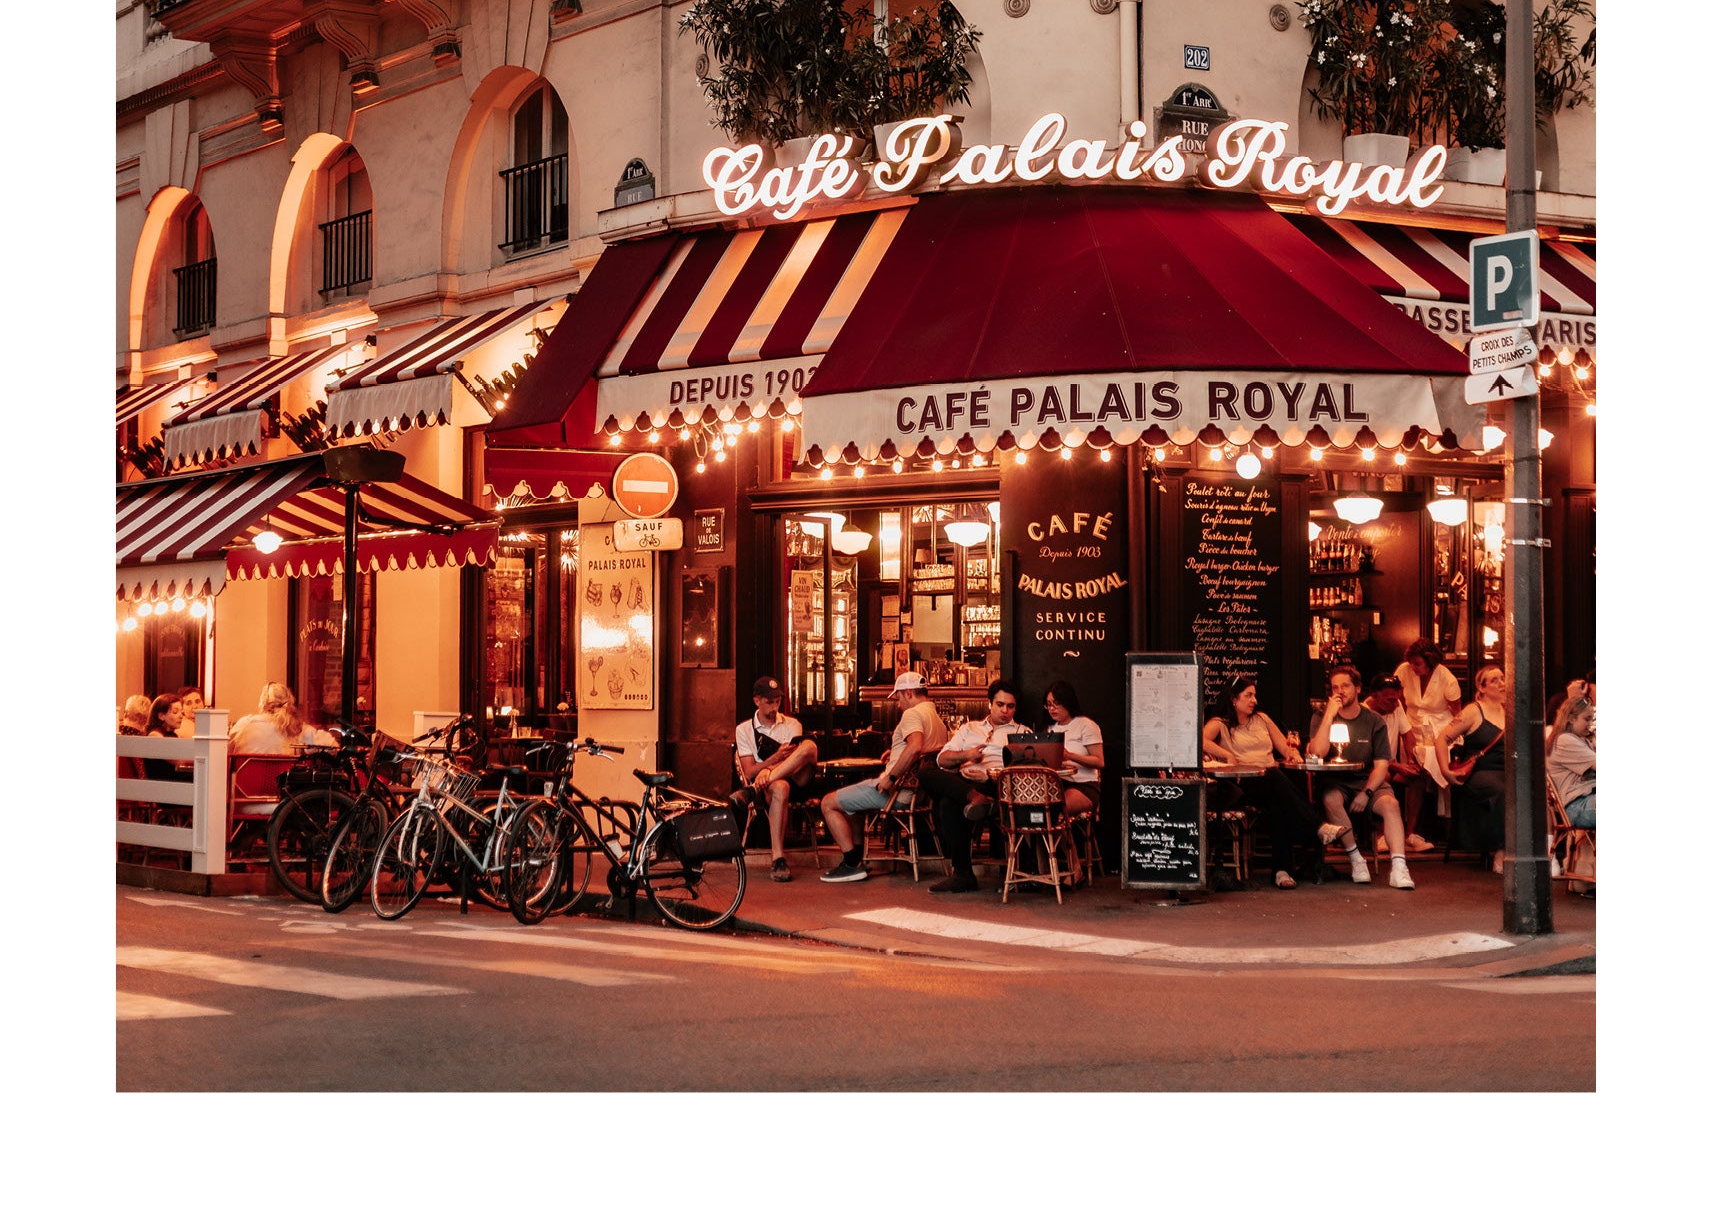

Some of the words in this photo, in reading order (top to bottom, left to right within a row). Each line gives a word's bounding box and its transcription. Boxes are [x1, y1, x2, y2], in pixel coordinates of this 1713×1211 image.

[1187, 48, 1208, 67] 202
[1182, 120, 1209, 136] RUE
[703, 134, 859, 220] Café
[874, 113, 1187, 193] Palais
[1208, 119, 1445, 216] Royal
[1487, 255, 1513, 311] P
[1480, 339, 1499, 353] CROIX
[1501, 336, 1514, 348] DES
[1472, 354, 1496, 370] PETITS
[1498, 345, 1533, 365] CHAMPS
[669, 373, 755, 406] DEPUIS
[896, 385, 992, 434] CAFÉ
[1010, 381, 1182, 428] PALAIS
[1208, 381, 1370, 423] ROYAL
[635, 523, 663, 532] SAUF
[702, 516, 716, 527] RUE
[1027, 512, 1113, 541] CAFÉ
[697, 534, 720, 545] VALOIS
[1039, 545, 1073, 563] Depuis
[1077, 546, 1101, 558] 1903
[588, 560, 617, 571] PALAIS
[620, 558, 646, 570] ROYAL
[1018, 573, 1073, 600] PALAIS
[1075, 571, 1128, 600] ROYAL
[1036, 612, 1106, 623] SERVICE
[1036, 629, 1105, 641] CONTINU
